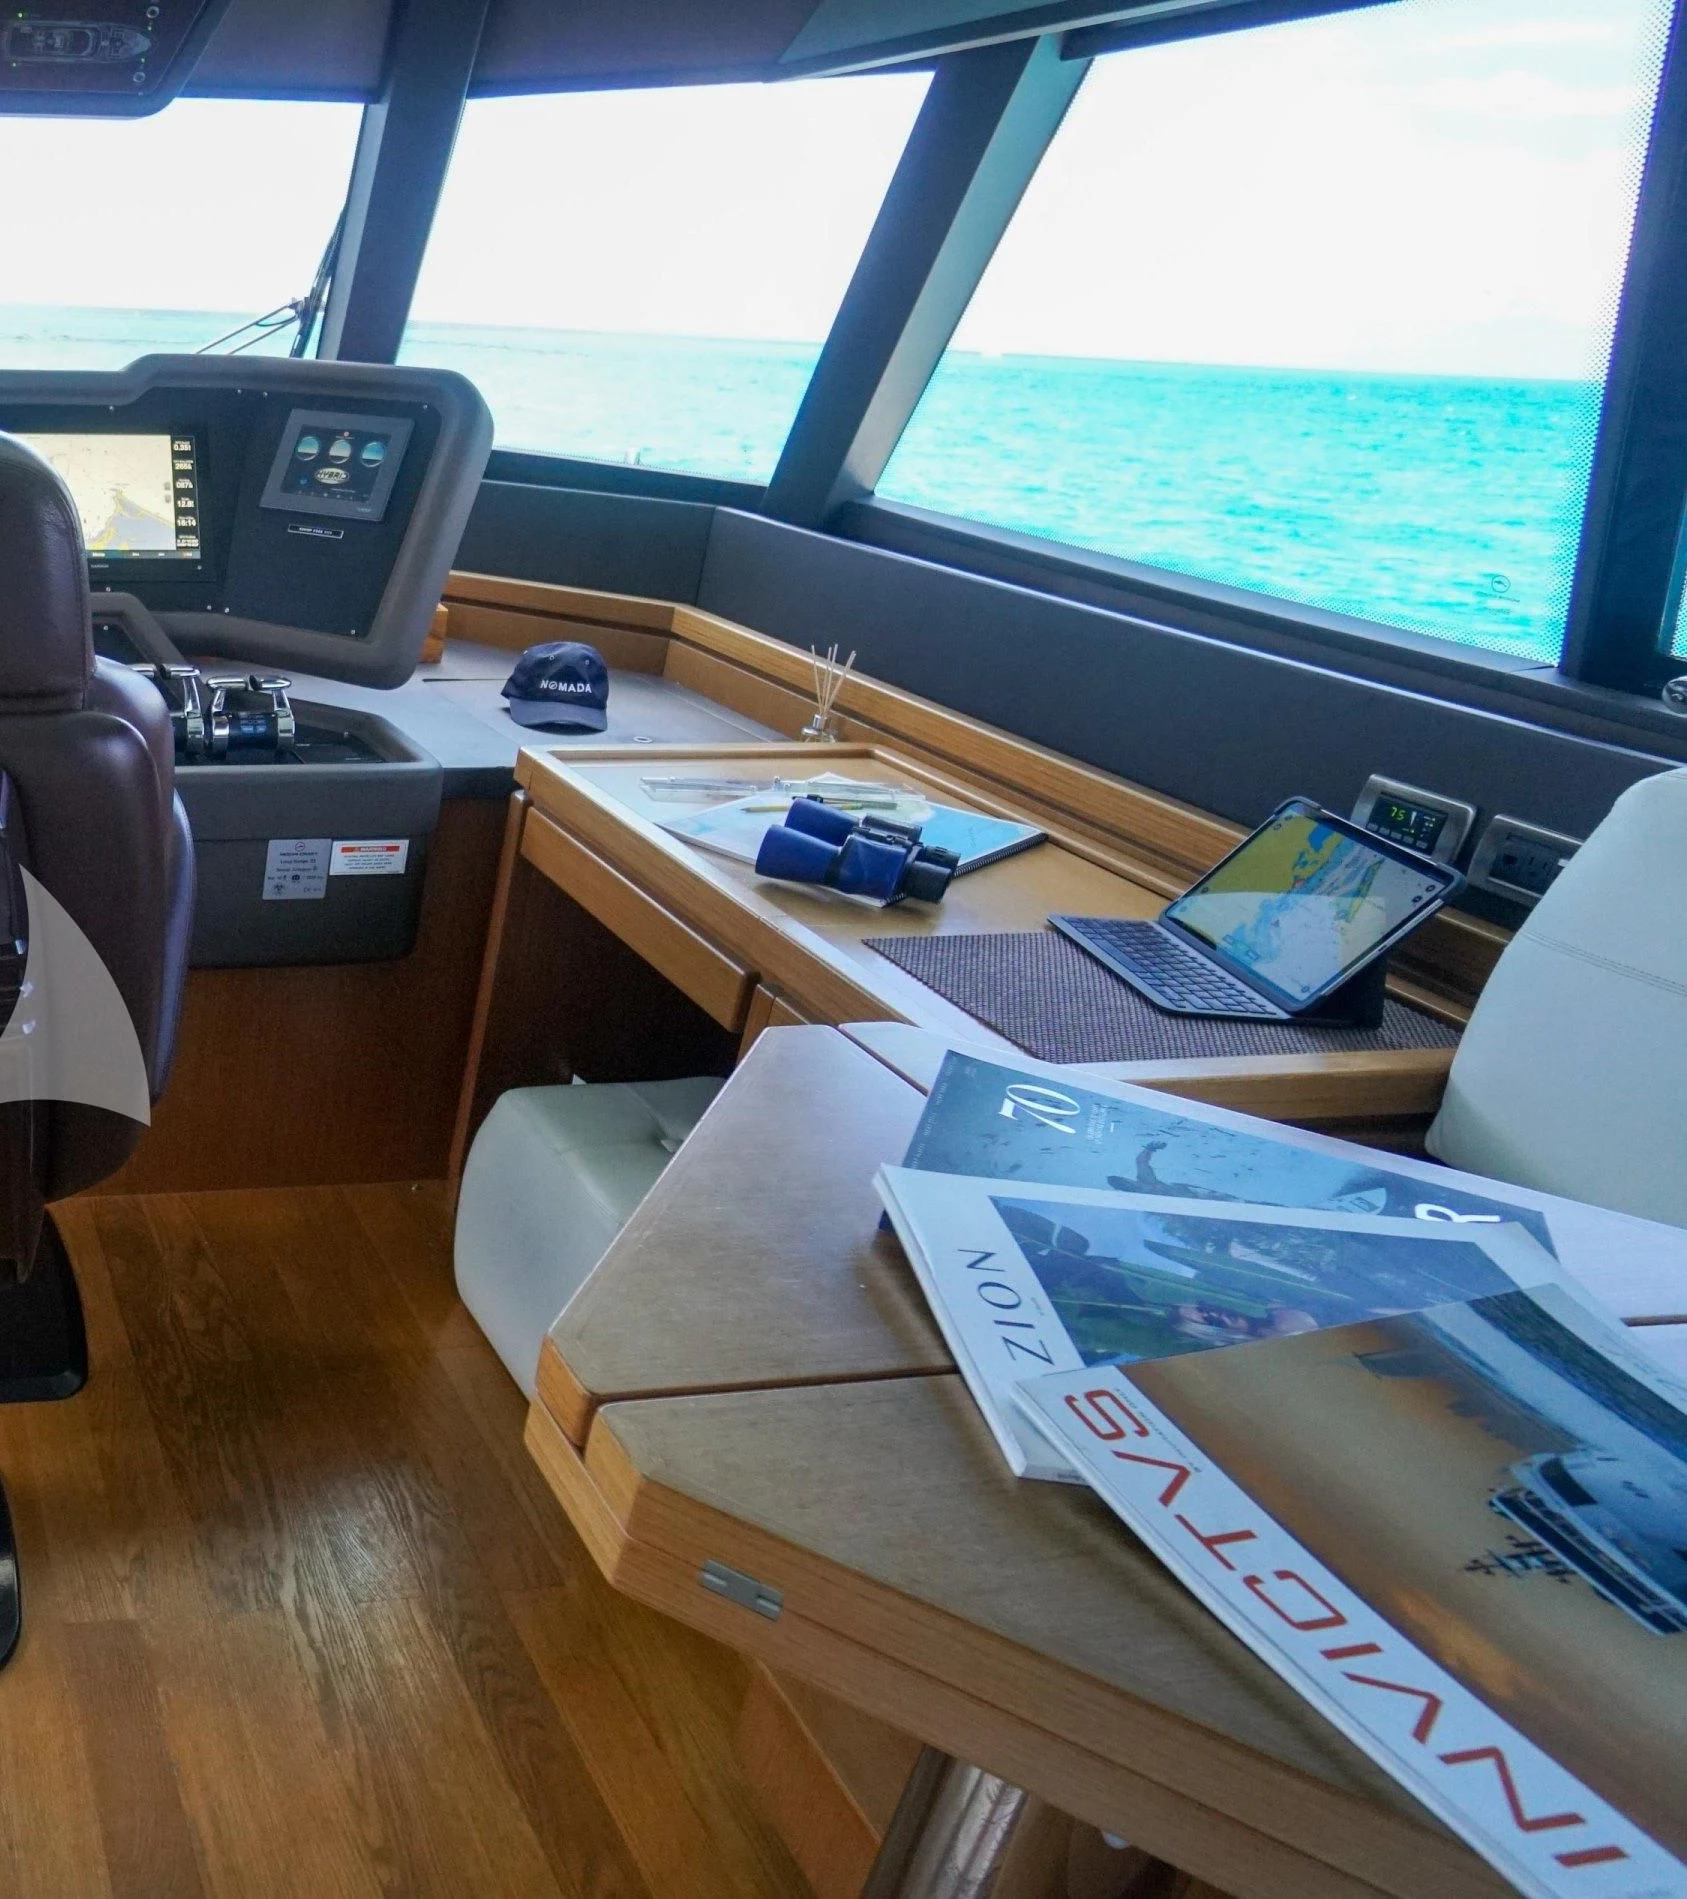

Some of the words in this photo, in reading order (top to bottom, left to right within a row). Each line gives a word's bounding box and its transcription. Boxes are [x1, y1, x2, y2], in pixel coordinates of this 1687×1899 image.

[540, 680, 592, 693] NOMADA
[1391, 806, 1405, 820] 75
[998, 1084, 1080, 1134] 70
[957, 1249, 1055, 1366] ZION
[1064, 1389, 1629, 1867] INVICTVS
